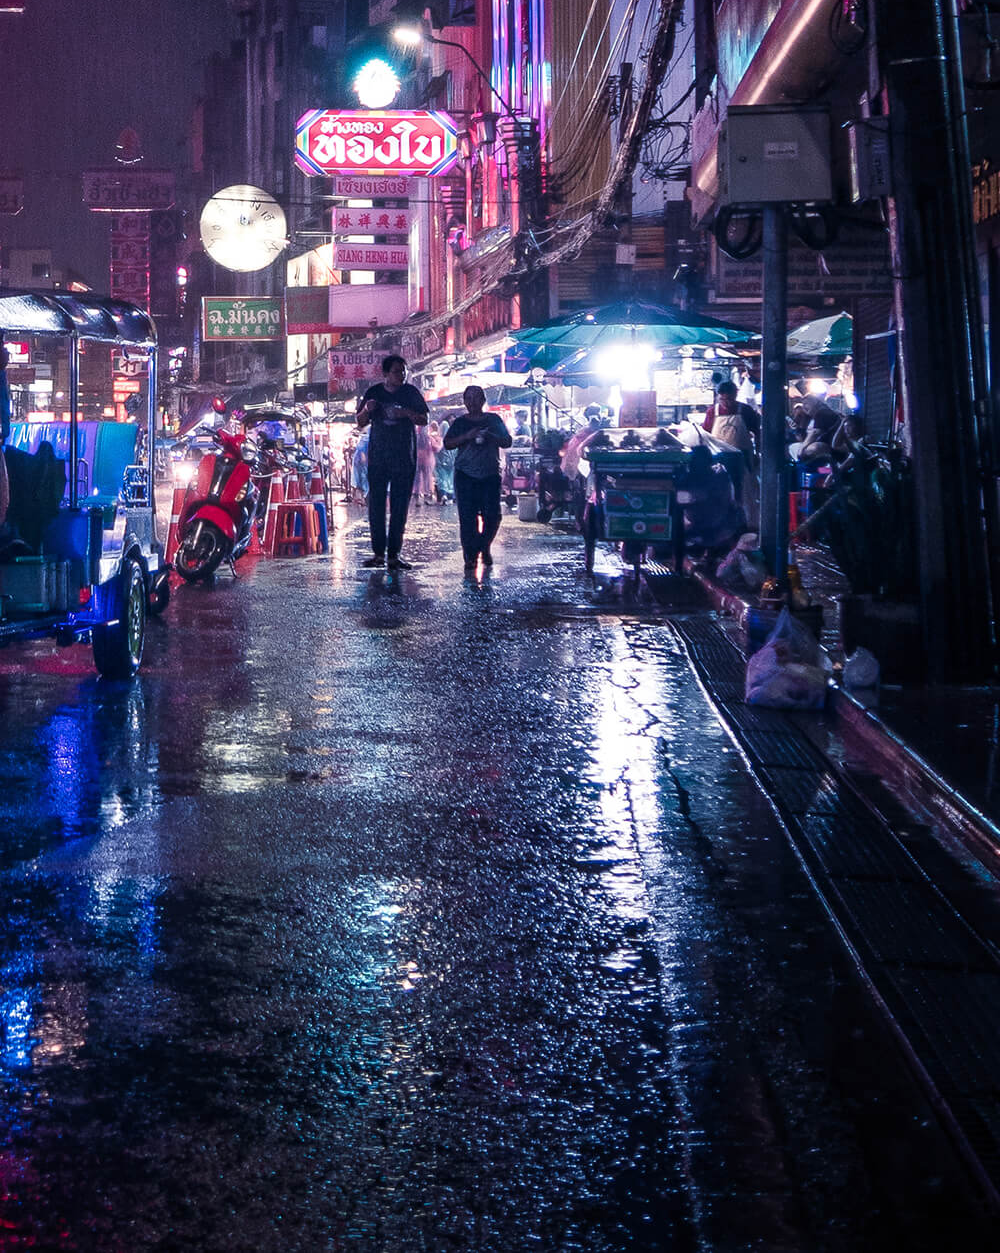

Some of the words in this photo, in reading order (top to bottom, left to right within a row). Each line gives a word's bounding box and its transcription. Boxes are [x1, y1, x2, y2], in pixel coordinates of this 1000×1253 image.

[319, 116, 384, 134] ห้างทอง
[337, 249, 363, 262] SIANG
[365, 250, 388, 264] HENG
